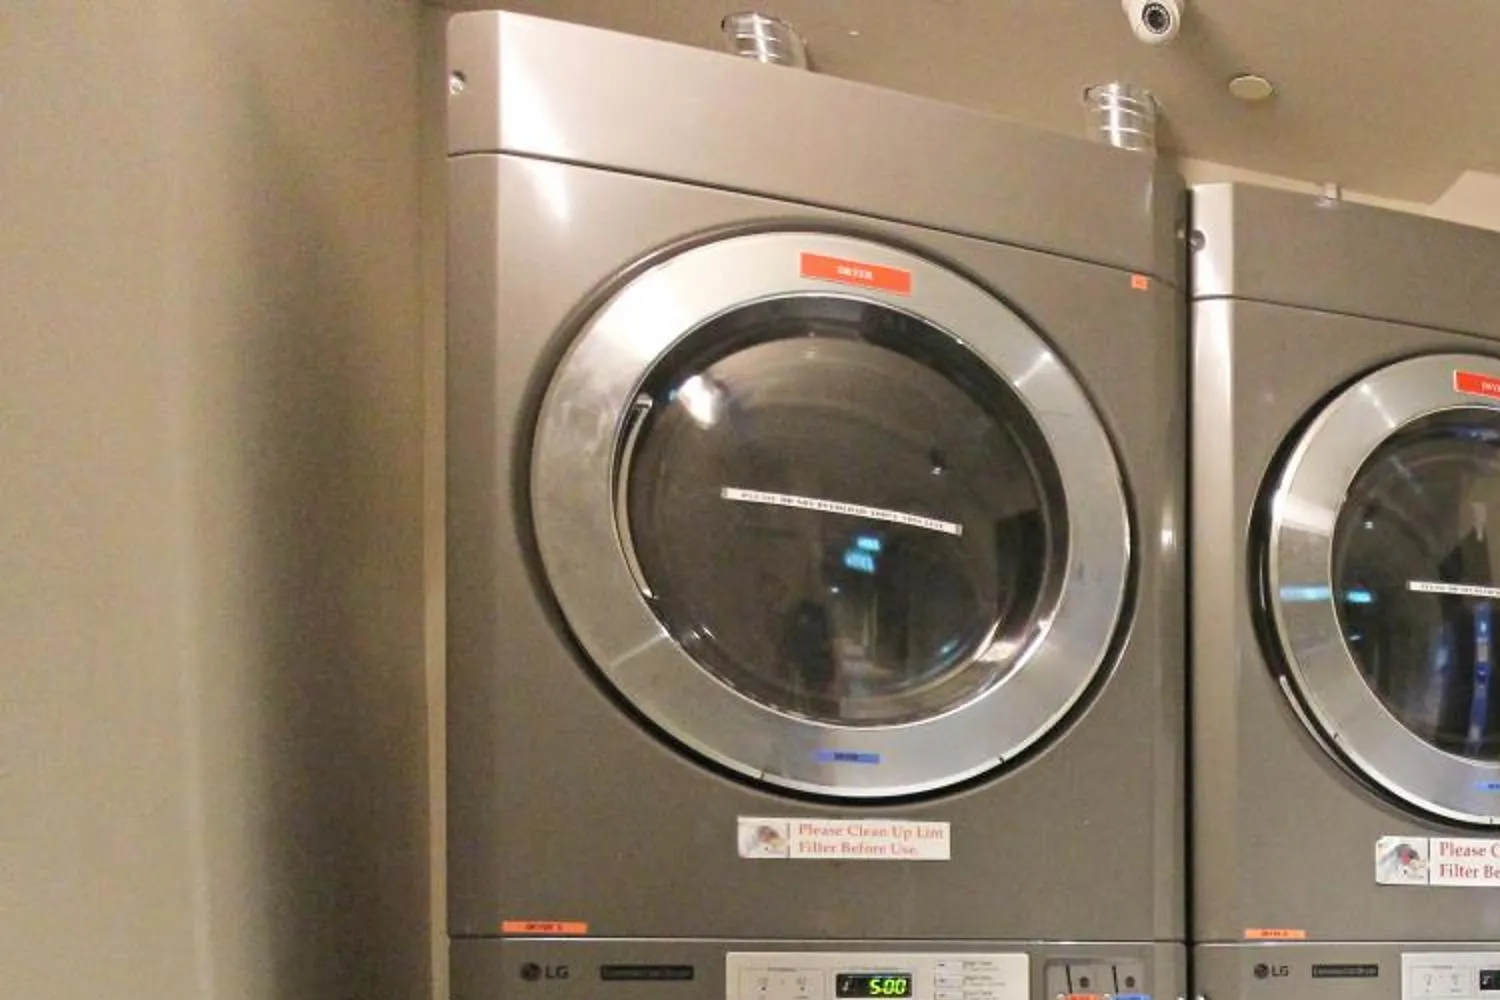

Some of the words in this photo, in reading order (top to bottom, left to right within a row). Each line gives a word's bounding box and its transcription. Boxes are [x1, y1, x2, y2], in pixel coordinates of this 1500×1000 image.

[798, 823, 842, 837] Please
[847, 823, 887, 838] Clean
[892, 824, 912, 840] Up
[917, 826, 944, 839] Lint
[798, 842, 836, 854] Filter
[841, 842, 886, 855] Before
[1439, 841, 1486, 857] Please
[1439, 863, 1479, 879] Filter
[546, 965, 569, 980] LG
[1272, 965, 1289, 977] LG
